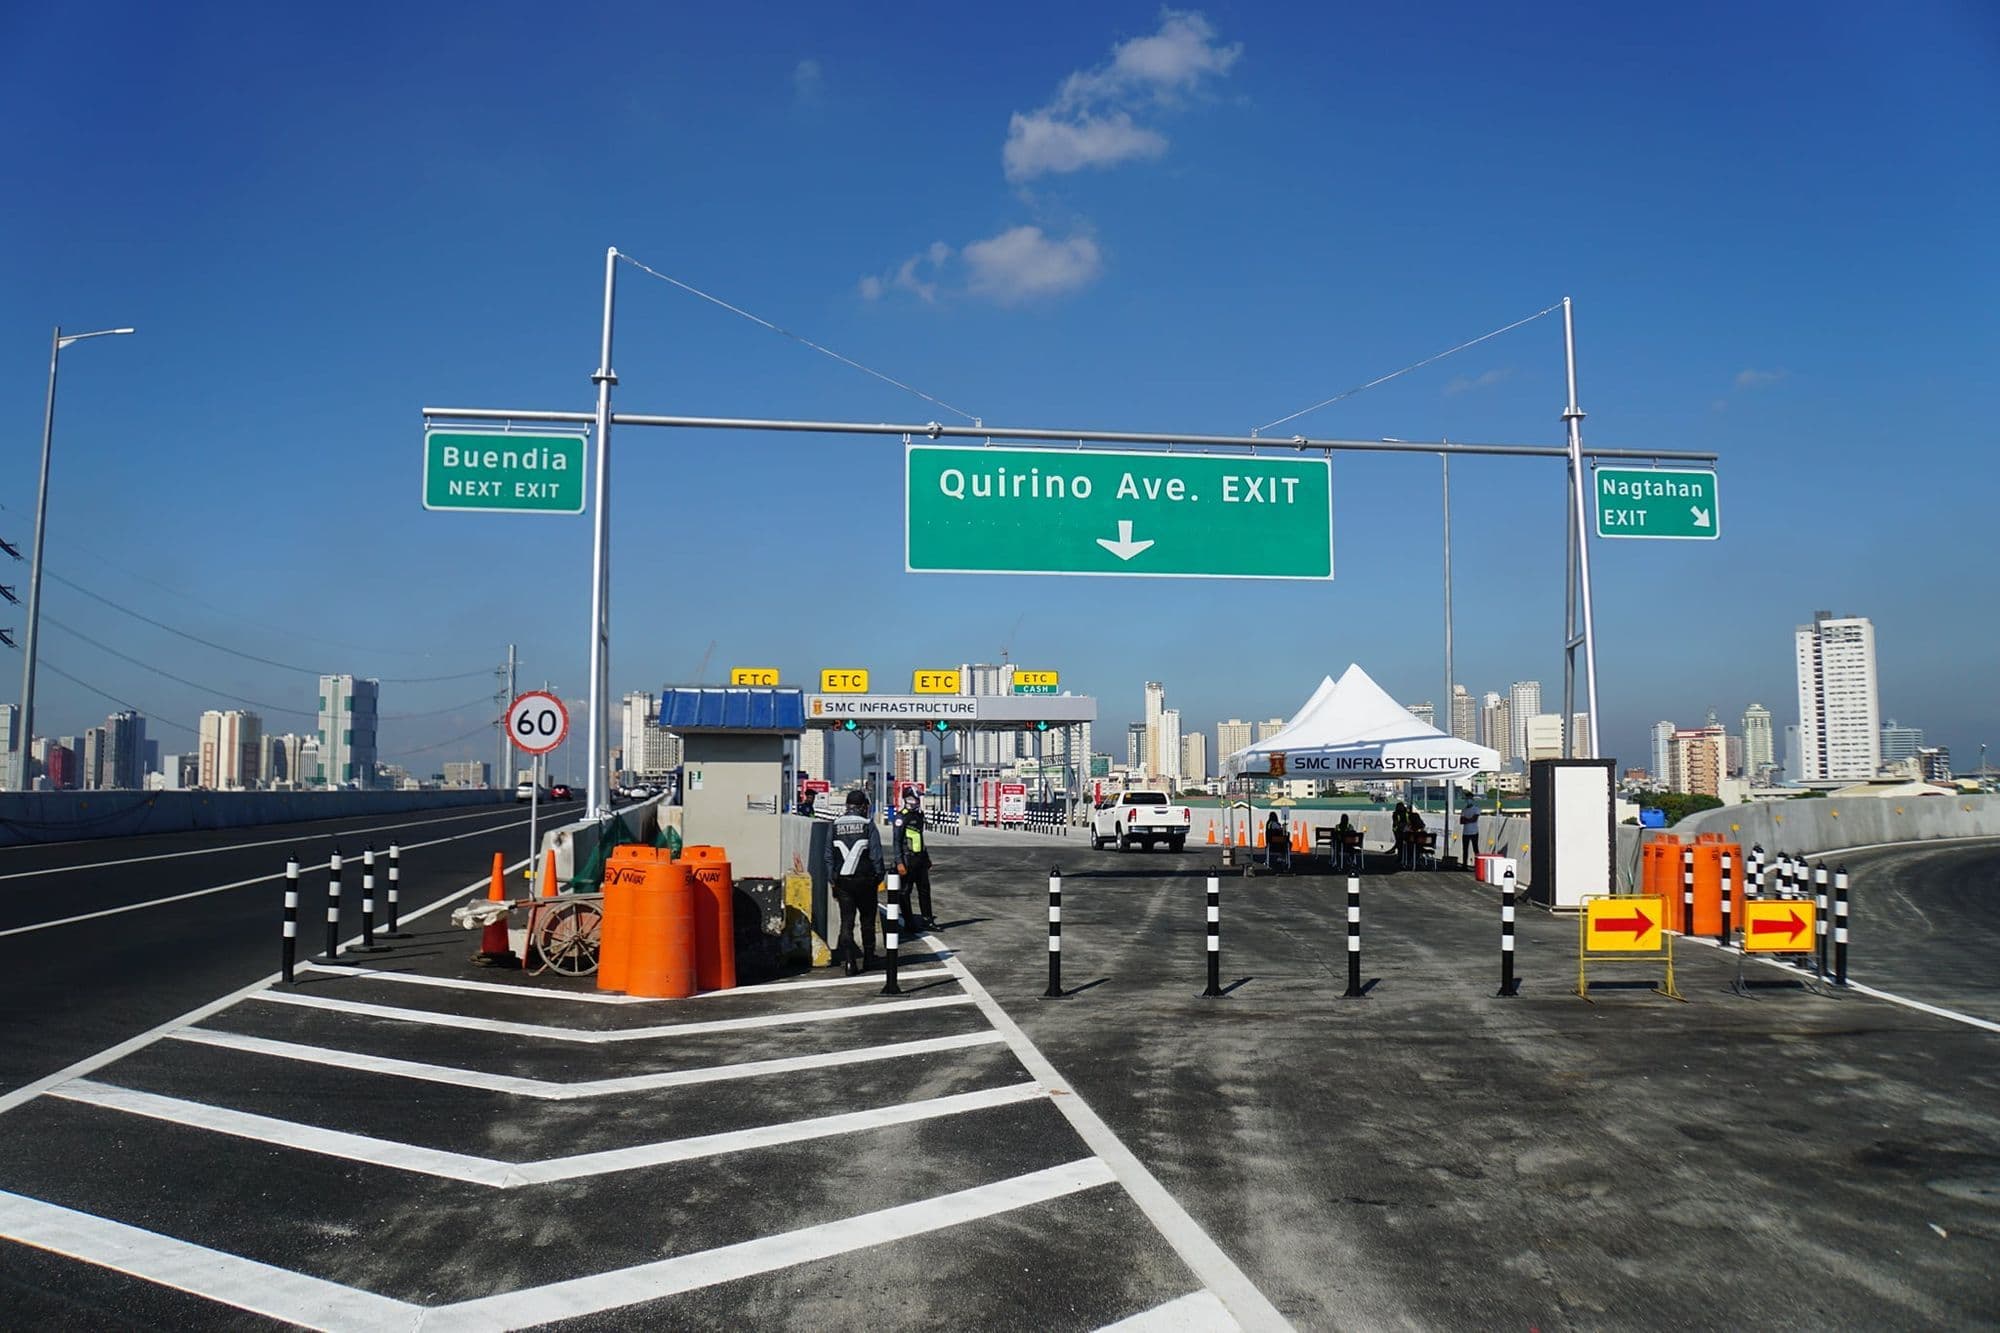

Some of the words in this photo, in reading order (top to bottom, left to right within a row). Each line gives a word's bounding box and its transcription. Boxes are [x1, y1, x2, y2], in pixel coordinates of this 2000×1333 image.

[443, 446, 567, 470] Buendia
[449, 480, 502, 497] NEXT
[514, 482, 560, 499] EXIT
[939, 467, 1093, 501] Quirino
[1116, 472, 1200, 502] Ave.
[1222, 475, 1300, 503] EXIT
[1603, 479, 1702, 500] Nagtahan
[1604, 509, 1647, 526] EXIT
[738, 674, 772, 686] ETC
[828, 675, 862, 687] ETC
[920, 676, 953, 688] ETC
[1024, 674, 1047, 683] ETC
[1023, 685, 1049, 693] CASH
[825, 702, 856, 713] SMC
[859, 703, 975, 714] INFRASTRUCTURE
[517, 709, 557, 736] 60
[1295, 757, 1330, 769] SMC
[1336, 757, 1480, 769] INFRASTRUCTURE
